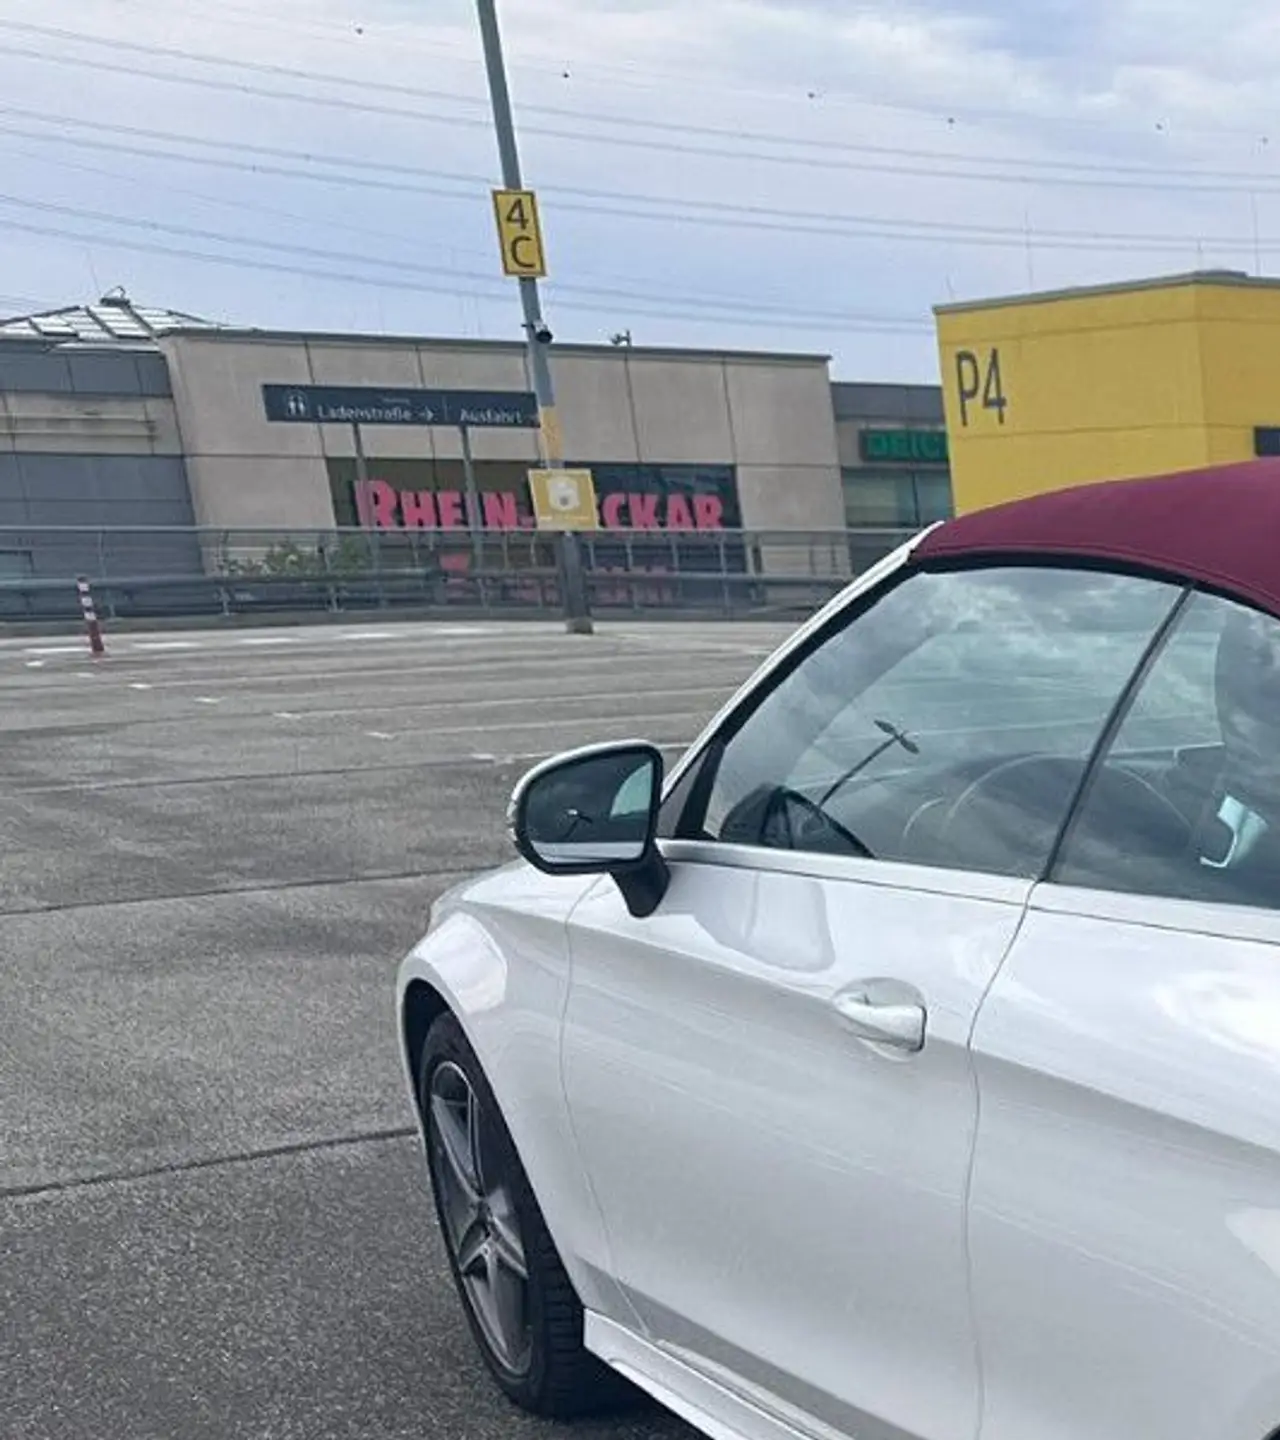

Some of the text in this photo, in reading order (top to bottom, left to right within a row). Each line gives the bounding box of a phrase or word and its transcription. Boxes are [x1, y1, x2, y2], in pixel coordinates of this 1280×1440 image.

[506, 198, 529, 230] 4
[511, 235, 535, 268] C
[956, 348, 1007, 427] P4
